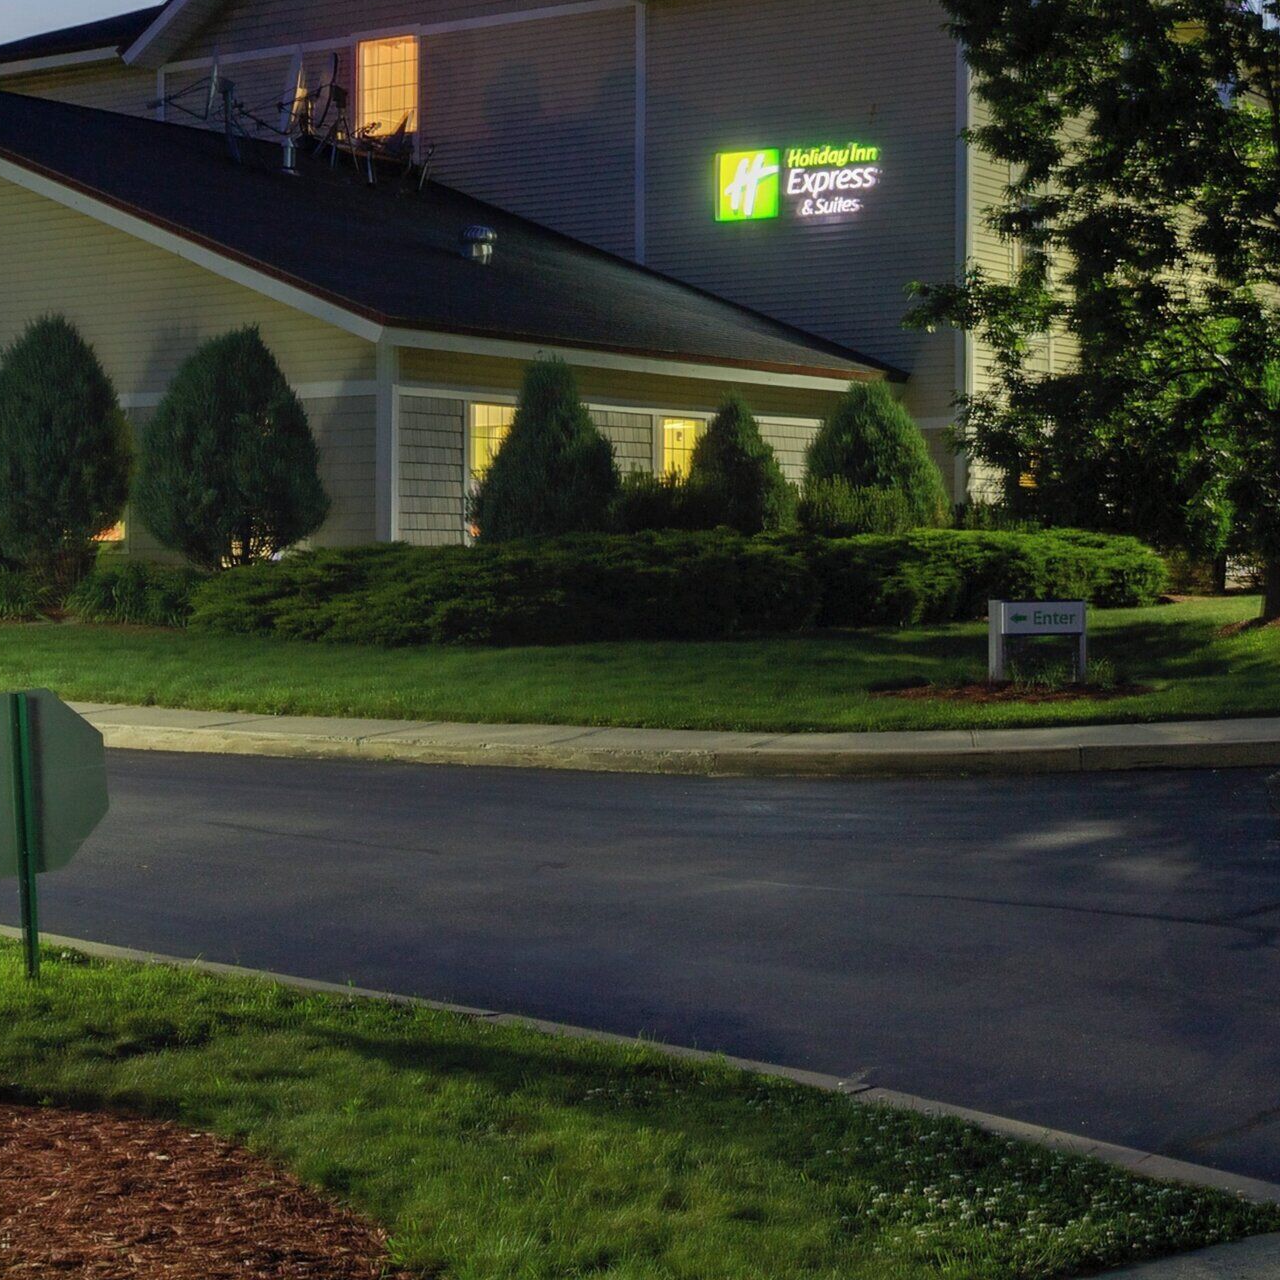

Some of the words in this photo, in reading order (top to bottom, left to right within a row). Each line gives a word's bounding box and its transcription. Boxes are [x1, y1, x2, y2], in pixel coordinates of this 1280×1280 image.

[787, 145, 849, 168] Holiday
[850, 143, 879, 162] Inn
[786, 167, 878, 198] Express
[801, 198, 814, 216] &
[815, 197, 861, 215] Suites
[1033, 610, 1076, 625] Enter
